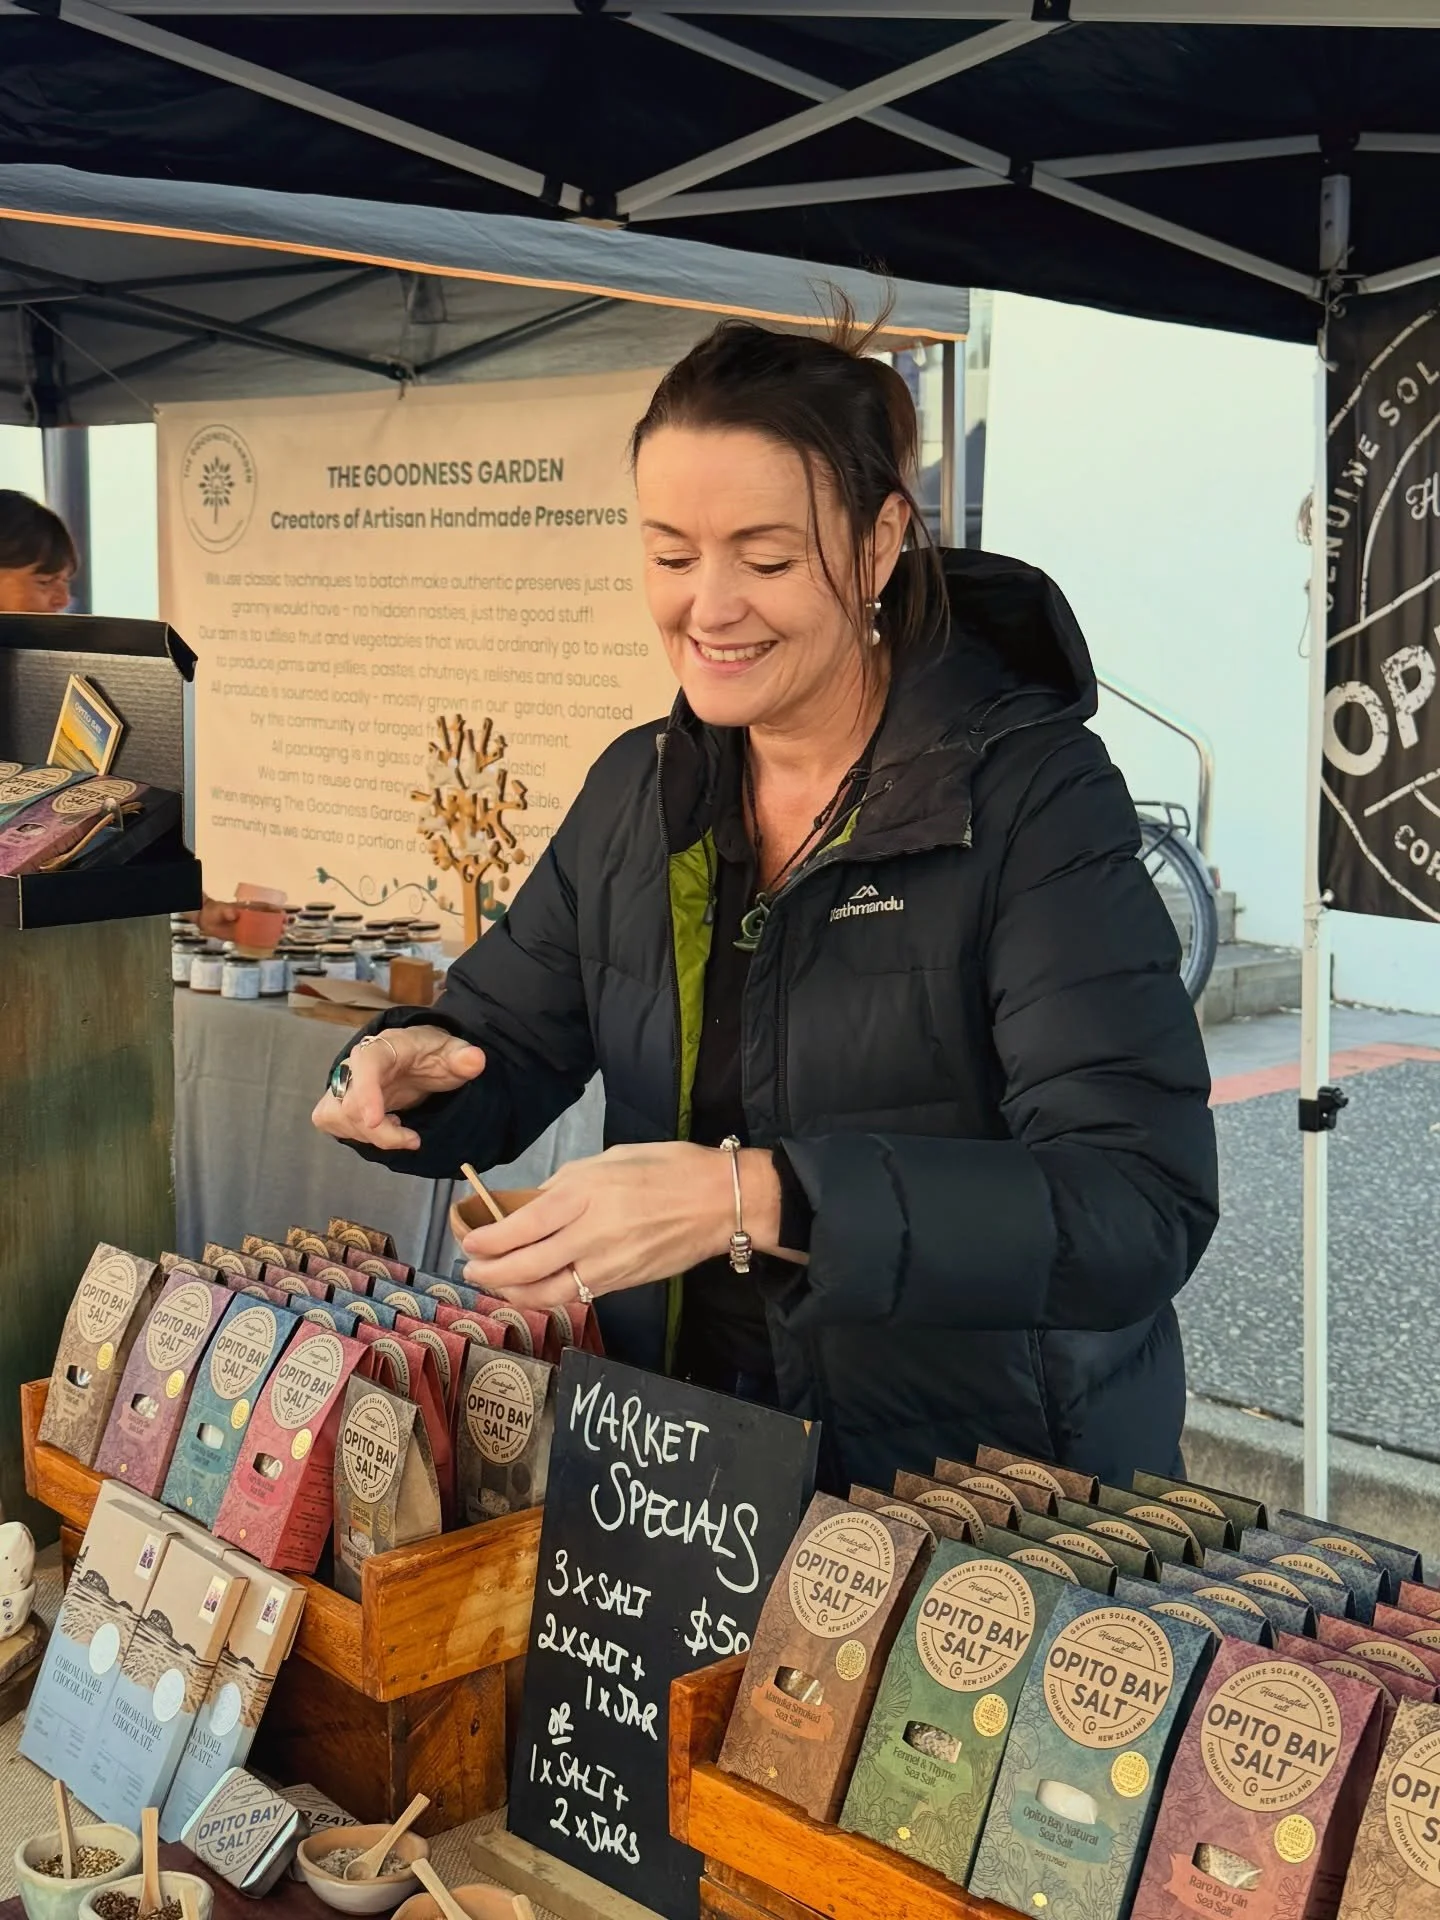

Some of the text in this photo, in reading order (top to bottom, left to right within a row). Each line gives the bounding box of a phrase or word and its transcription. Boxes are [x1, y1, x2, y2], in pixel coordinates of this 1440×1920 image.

[327, 458, 564, 488] THE GOODNESS GARDEN
[270, 505, 628, 530] Creators of Artisan Handmade Preserves
[369, 574, 409, 589] batch
[411, 575, 448, 591] make
[451, 574, 513, 591] authentic
[515, 577, 581, 595] preserves
[584, 576, 611, 596] just
[613, 579, 634, 592] as
[372, 604, 414, 619] hidden
[471, 605, 494, 624] just
[496, 605, 516, 621] the
[520, 607, 555, 626] good
[558, 605, 594, 624] stuff!
[425, 633, 453, 650] that
[455, 635, 494, 652] would
[498, 635, 557, 659] ordinarily
[562, 640, 580, 660] go
[583, 639, 599, 656] to
[602, 640, 649, 657] waste
[483, 664, 534, 685] relishes
[536, 666, 562, 686] and
[567, 670, 622, 689] sauces.
[567, 703, 634, 721] donated
[308, 798, 367, 818] Goodness
[82, 1283, 130, 1312] OPITO BAY
[88, 1305, 111, 1325] SALT
[153, 1311, 204, 1341] OPITO BAY
[158, 1332, 183, 1352] SALT
[216, 1336, 268, 1367] OPITO BAY
[222, 1359, 248, 1380] SALT
[278, 1364, 334, 1397] OPITO BAY
[283, 1387, 311, 1409] SALT
[468, 1394, 532, 1429] OPITO BAY
[483, 1419, 513, 1443] SALT
[570, 1382, 710, 1467] MARKET
[344, 1428, 397, 1469] OPITO BAY
[355, 1456, 380, 1481] SALT
[590, 1461, 759, 1594] SPECIALS
[795, 1549, 888, 1599] OPITO BAY
[979, 1564, 1003, 1574] SOLAR
[810, 1581, 855, 1613] SALT
[683, 1596, 751, 1657] $50
[923, 1597, 1029, 1652] OPITO BAY
[1070, 1613, 1106, 1635] GENUINE
[1109, 1612, 1137, 1622] SOLAR
[940, 1631, 992, 1666] SALT
[55, 1654, 103, 1695] COROMANDEL
[1050, 1647, 1168, 1705] OPITO BAY
[1230, 1668, 1266, 1691] GENUINE
[1271, 1667, 1300, 1678] SOLAR
[774, 1709, 788, 1723] Sea
[1071, 1684, 1128, 1720] SALT
[115, 1696, 162, 1741] COROMANDEL
[547, 1702, 575, 1736] OR
[1116, 1717, 1146, 1740] ZEALAND
[1208, 1704, 1336, 1767] OPITO BAY
[893, 1746, 957, 1783] Fennel & Thyme
[904, 1765, 937, 1788] Sea Salt
[1231, 1743, 1292, 1782] SALT
[1280, 1780, 1312, 1802] ZEALAND
[198, 1803, 283, 1840] OPITO BAY
[1023, 1806, 1099, 1846] Opito Bay Natural
[216, 1829, 254, 1853] SALT
[1038, 1826, 1073, 1850] Sea Salt
[1394, 1815, 1429, 1872] COROMANDEL
[1189, 1875, 1213, 1892] Rare
[1212, 1885, 1230, 1903] Dry
[1195, 1892, 1233, 1918] Sea Salt
